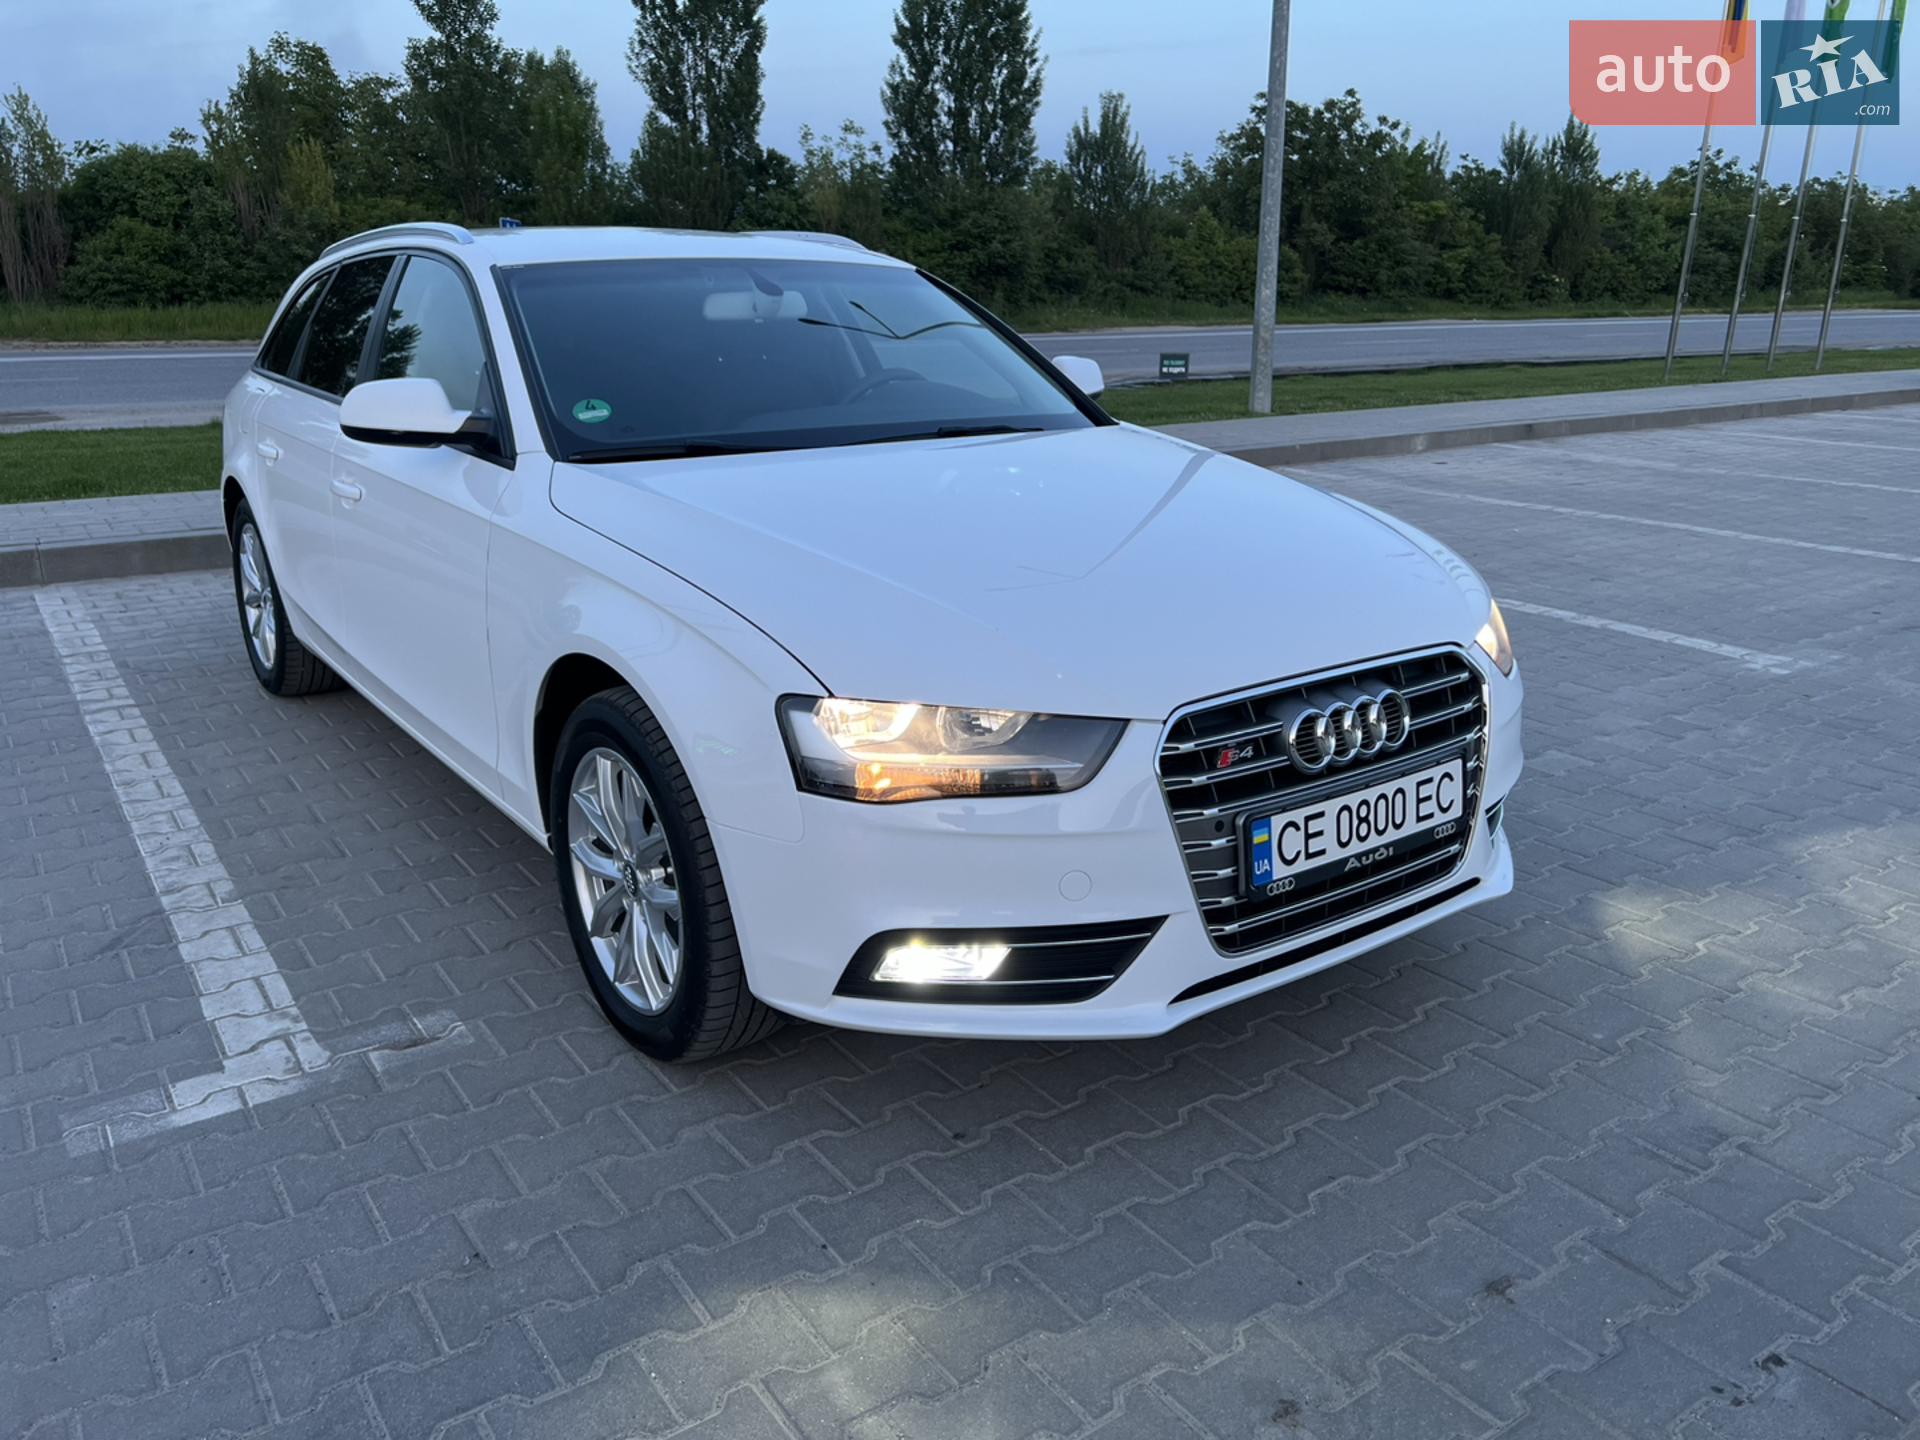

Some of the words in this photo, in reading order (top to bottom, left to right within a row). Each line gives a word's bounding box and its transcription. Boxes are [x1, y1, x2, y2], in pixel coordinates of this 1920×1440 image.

[1276, 810, 1327, 867] CE
[1336, 787, 1407, 849] 0800
[1415, 771, 1455, 824] EC
[1254, 858, 1271, 875] UA
